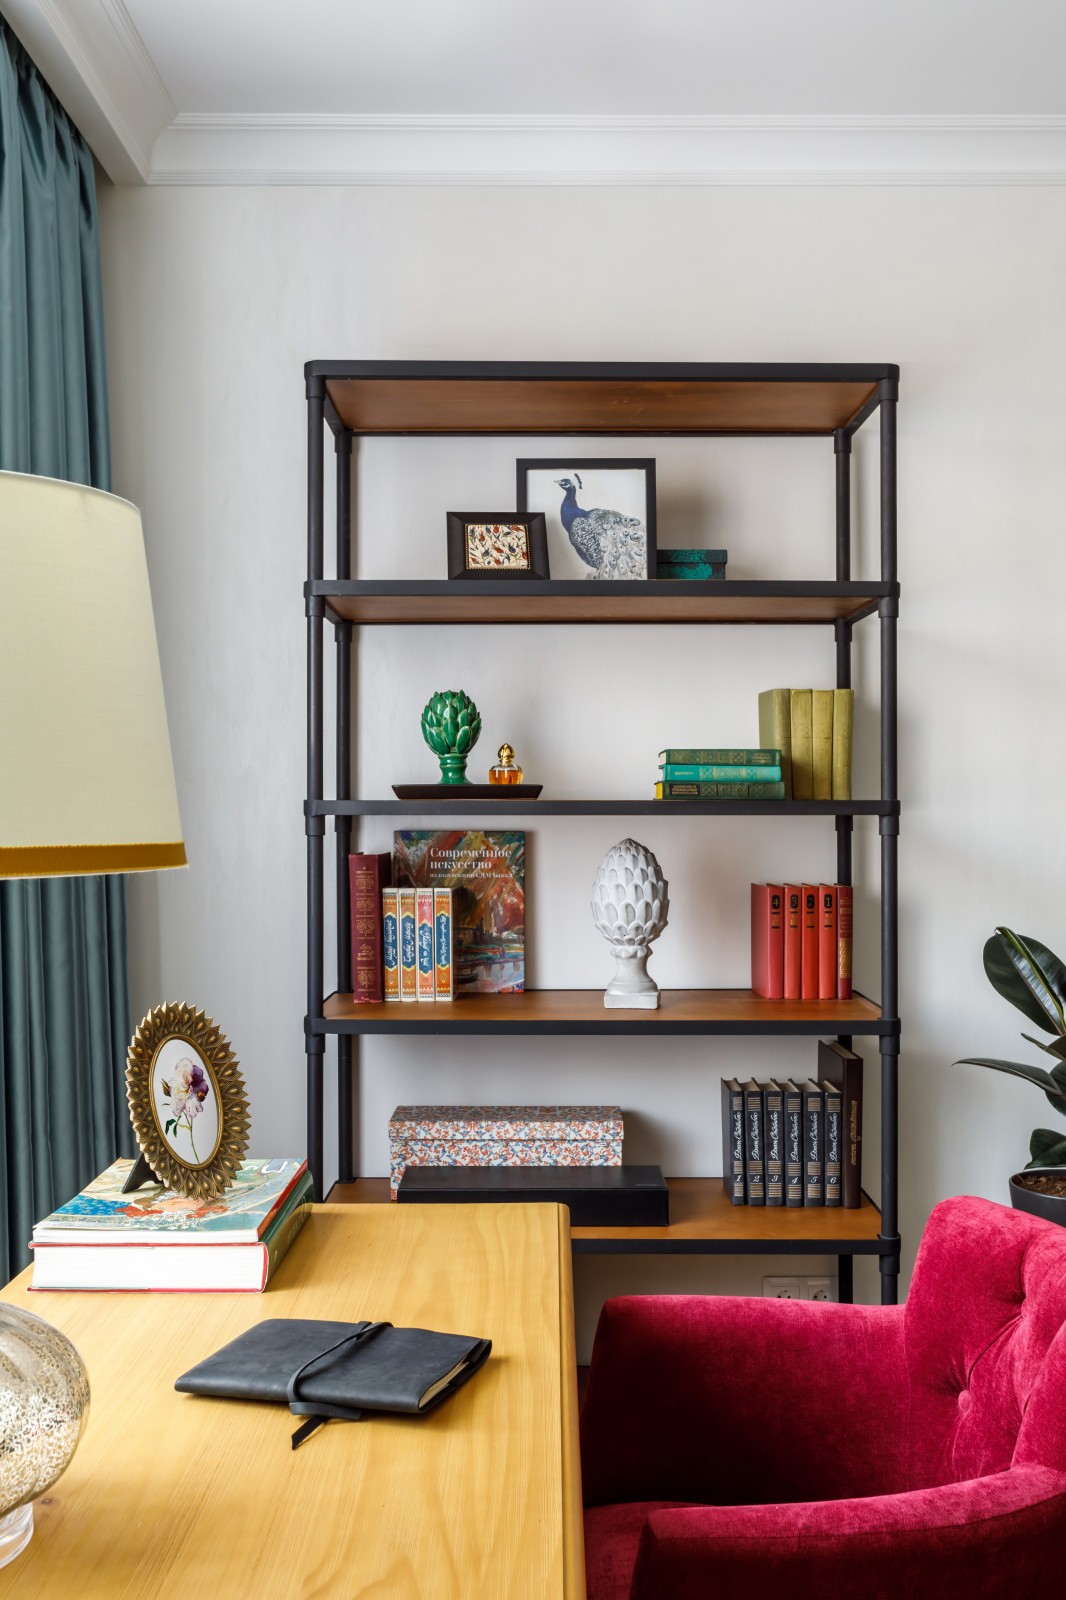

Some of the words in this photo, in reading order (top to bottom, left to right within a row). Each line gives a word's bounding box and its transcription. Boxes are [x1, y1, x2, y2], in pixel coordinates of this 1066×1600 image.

[430, 847, 512, 860] Современное
[430, 861, 492, 872] искусство
[773, 898, 779, 907] 4
[791, 896, 798, 907] 3
[807, 897, 814, 907] 2
[826, 897, 831, 907] 1
[735, 1174, 742, 1182] 1
[753, 1175, 760, 1183] 2
[791, 1176, 799, 1184] 4
[810, 1176, 818, 1184] 5
[830, 1176, 837, 1184] 6
